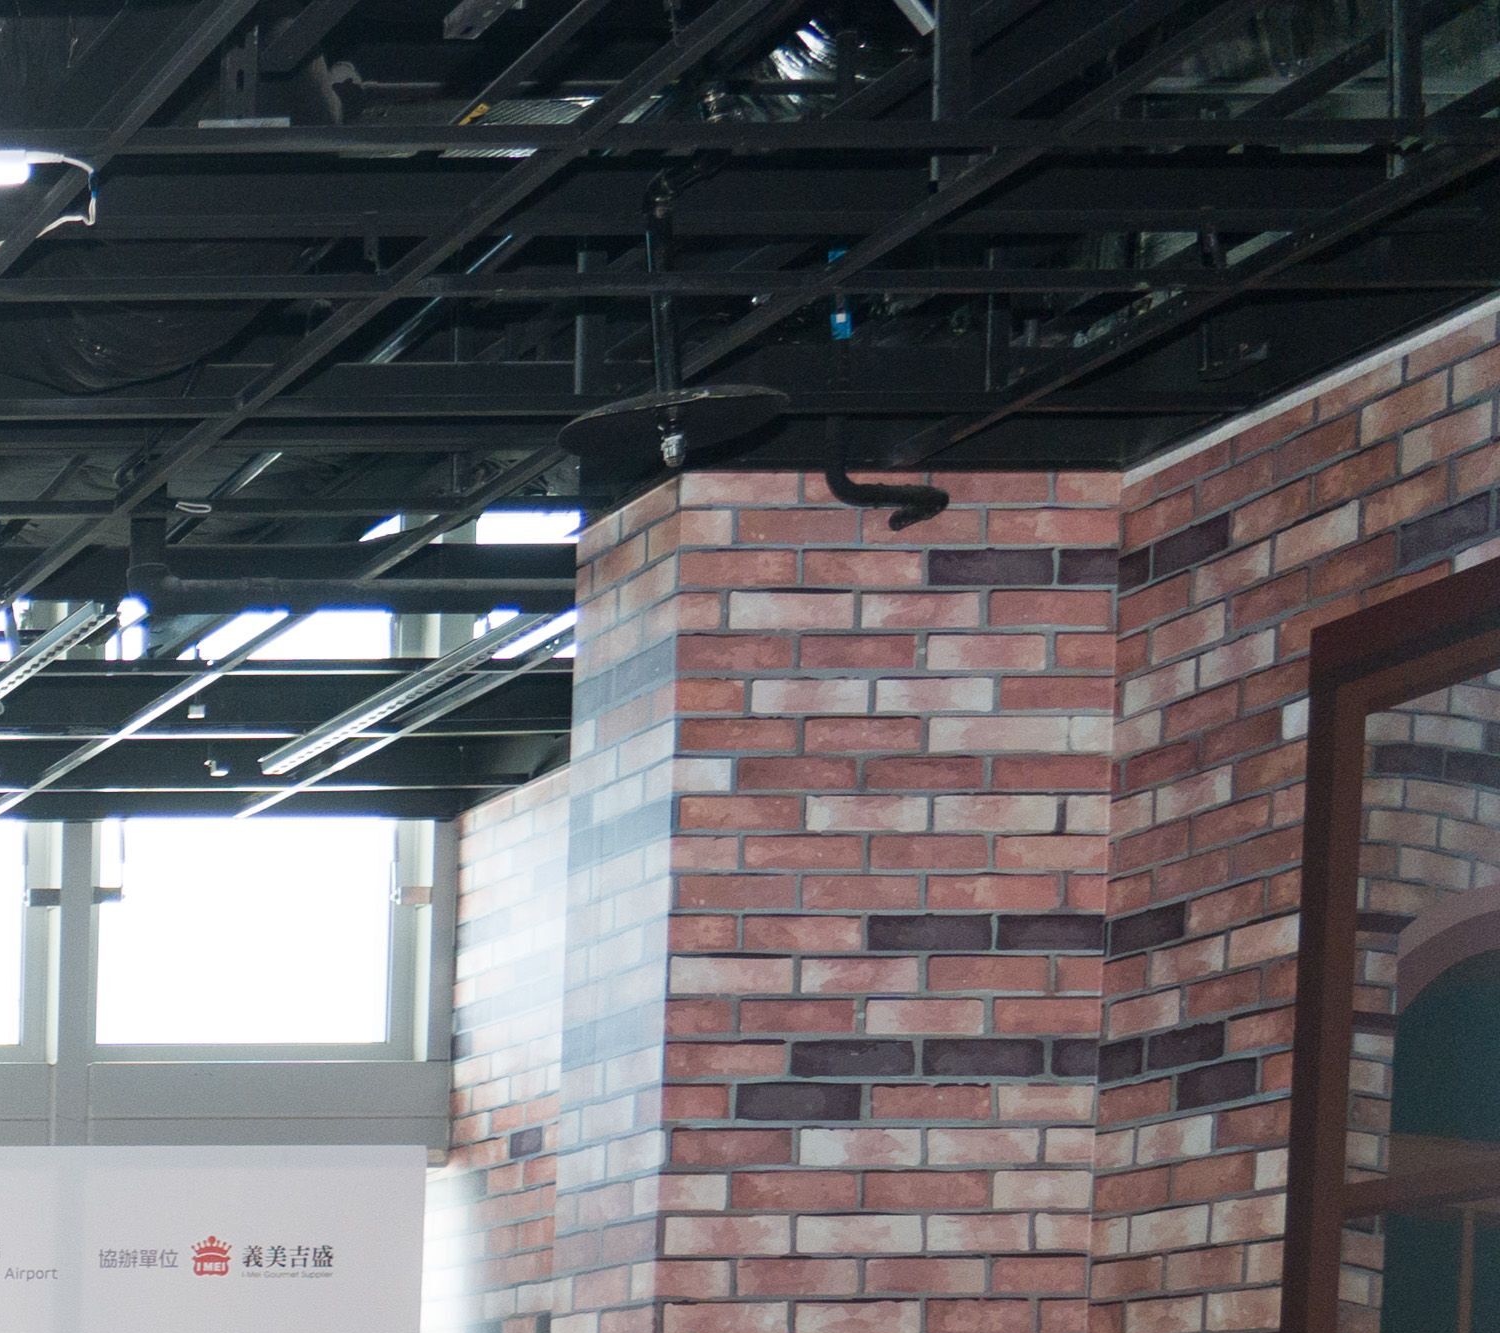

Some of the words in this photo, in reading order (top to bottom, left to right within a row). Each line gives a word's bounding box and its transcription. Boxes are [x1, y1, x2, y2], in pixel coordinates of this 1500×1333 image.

[98, 1249, 179, 1269] 協辦單位
[241, 1244, 334, 1268] 義美吉盛
[4, 1267, 59, 1283] Airport
